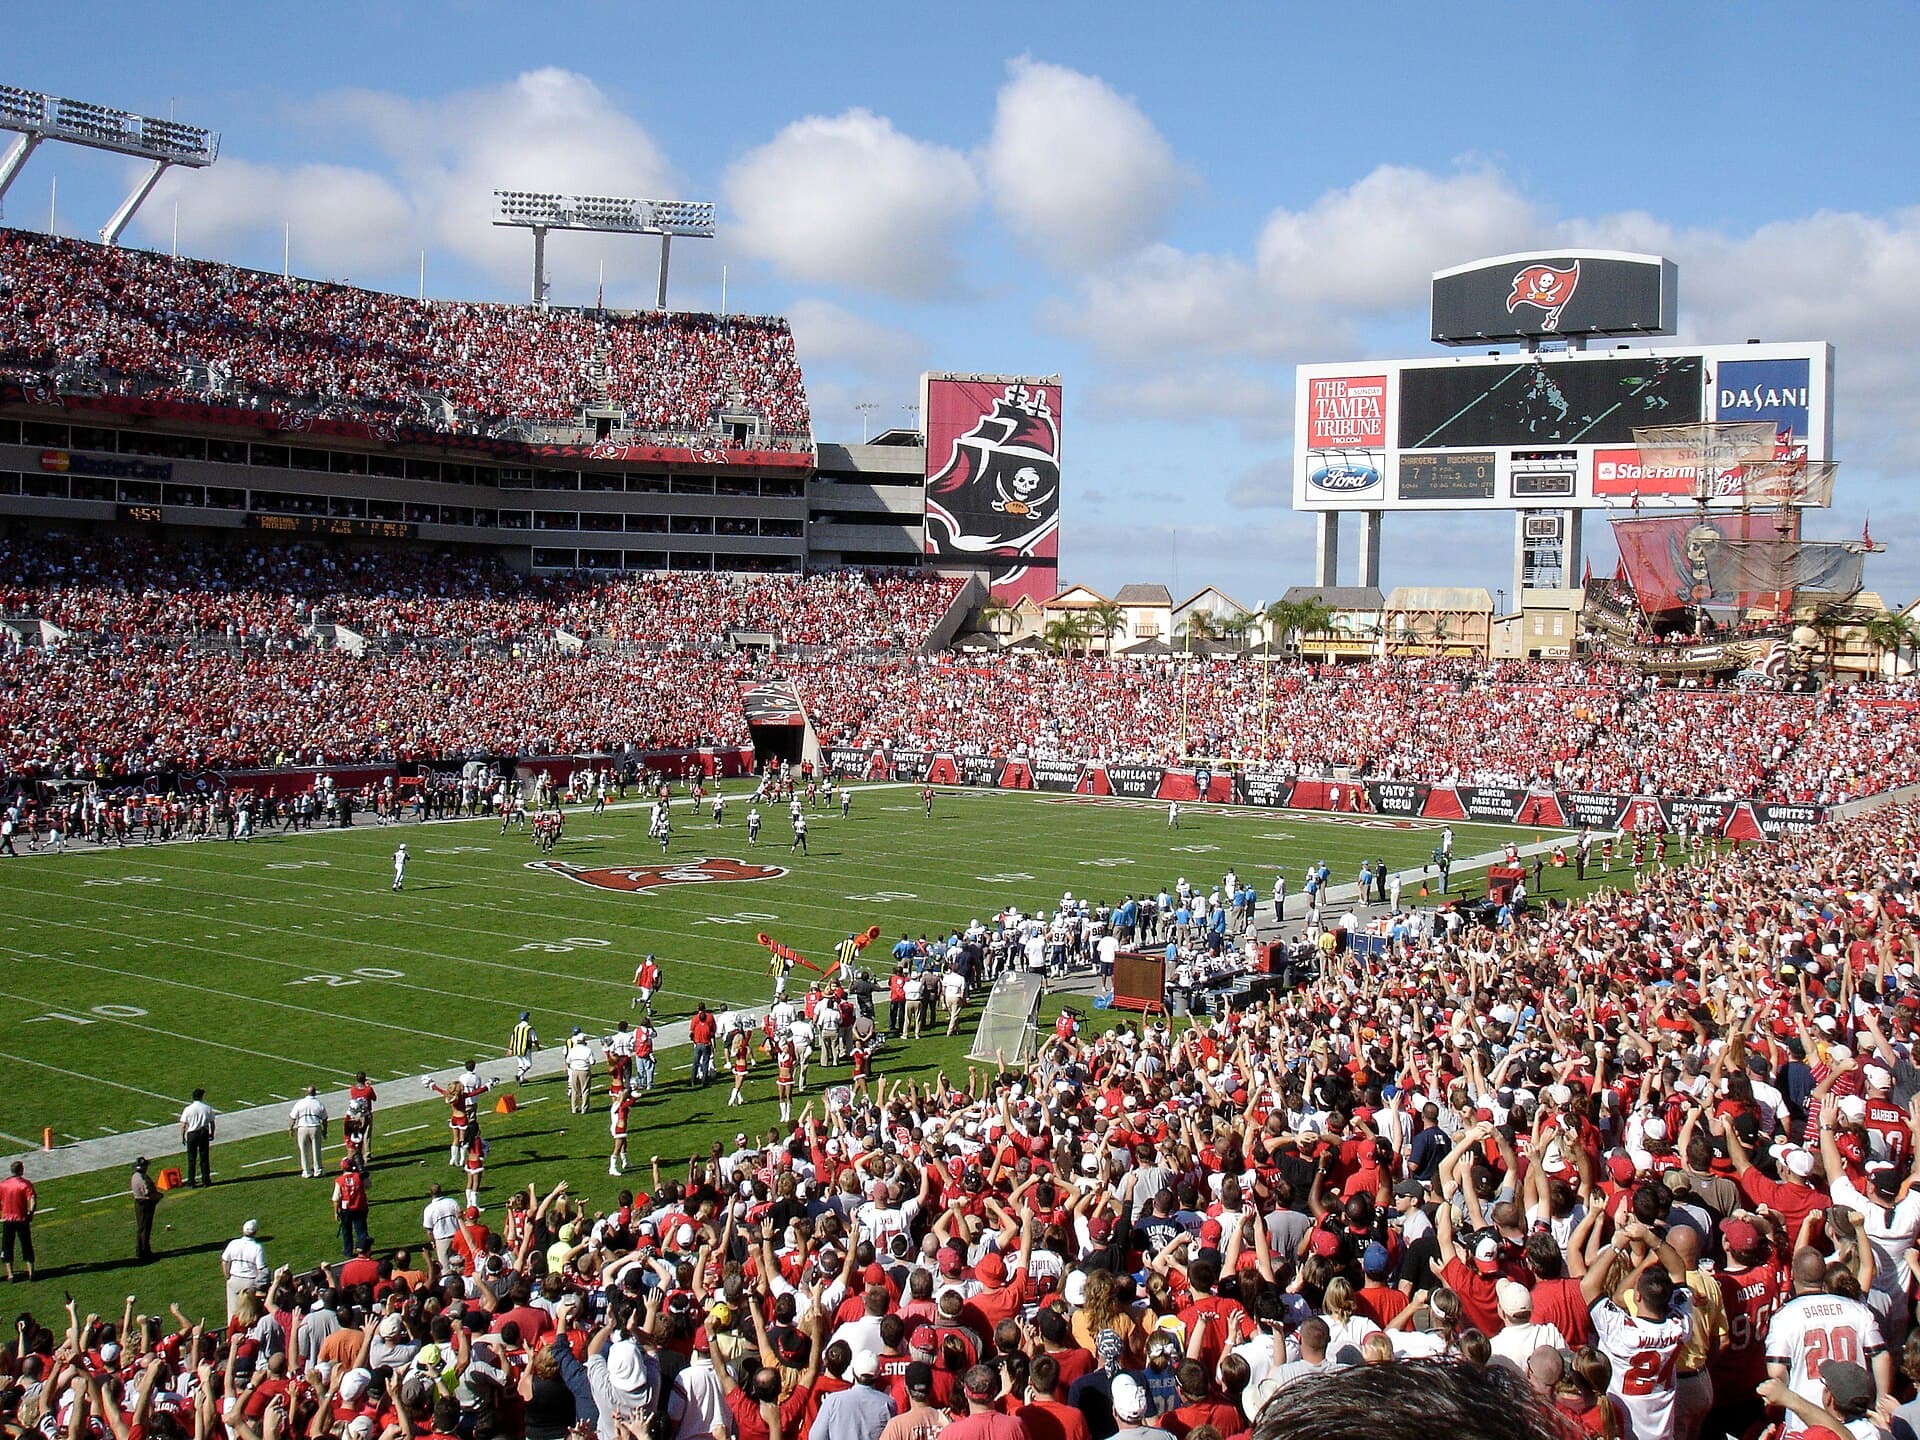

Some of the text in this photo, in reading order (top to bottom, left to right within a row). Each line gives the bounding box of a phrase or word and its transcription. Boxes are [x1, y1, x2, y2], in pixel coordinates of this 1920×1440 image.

[1314, 381, 1347, 398] THE
[1721, 384, 1808, 411] DASANI
[1314, 397, 1381, 419] TAMPA
[1314, 418, 1381, 437] TRIBUNE
[1322, 468, 1368, 488] Ford
[1413, 468, 1420, 480] 7
[1477, 466, 1485, 479] 0
[129, 507, 161, 521] 4:54
[1109, 769, 1160, 780] CADILLAC'S
[1123, 781, 1146, 792] KIDS
[1248, 788, 1280, 798] ADVIRY
[1379, 785, 1415, 797] CATO'S
[1478, 788, 1506, 798] GARCIA
[1253, 796, 1275, 804] BOAD
[1382, 798, 1412, 810] CREW
[1471, 796, 1490, 806] PASS
[1491, 798, 1500, 806] IT
[1469, 806, 1514, 817] FOUNDATION
[1767, 807, 1815, 820] WHITE'S
[1762, 820, 1815, 833] WARIOR
[304, 967, 405, 987] 20
[46, 1004, 148, 1025] 10
[1871, 1108, 1899, 1122] BARBER
[1030, 1259, 1051, 1271] STOTT
[1737, 1282, 1765, 1302] ADAMS
[1803, 1303, 1844, 1319] BARBER
[1639, 1333, 1683, 1348] WILLIAMS
[1804, 1325, 1857, 1380] 20
